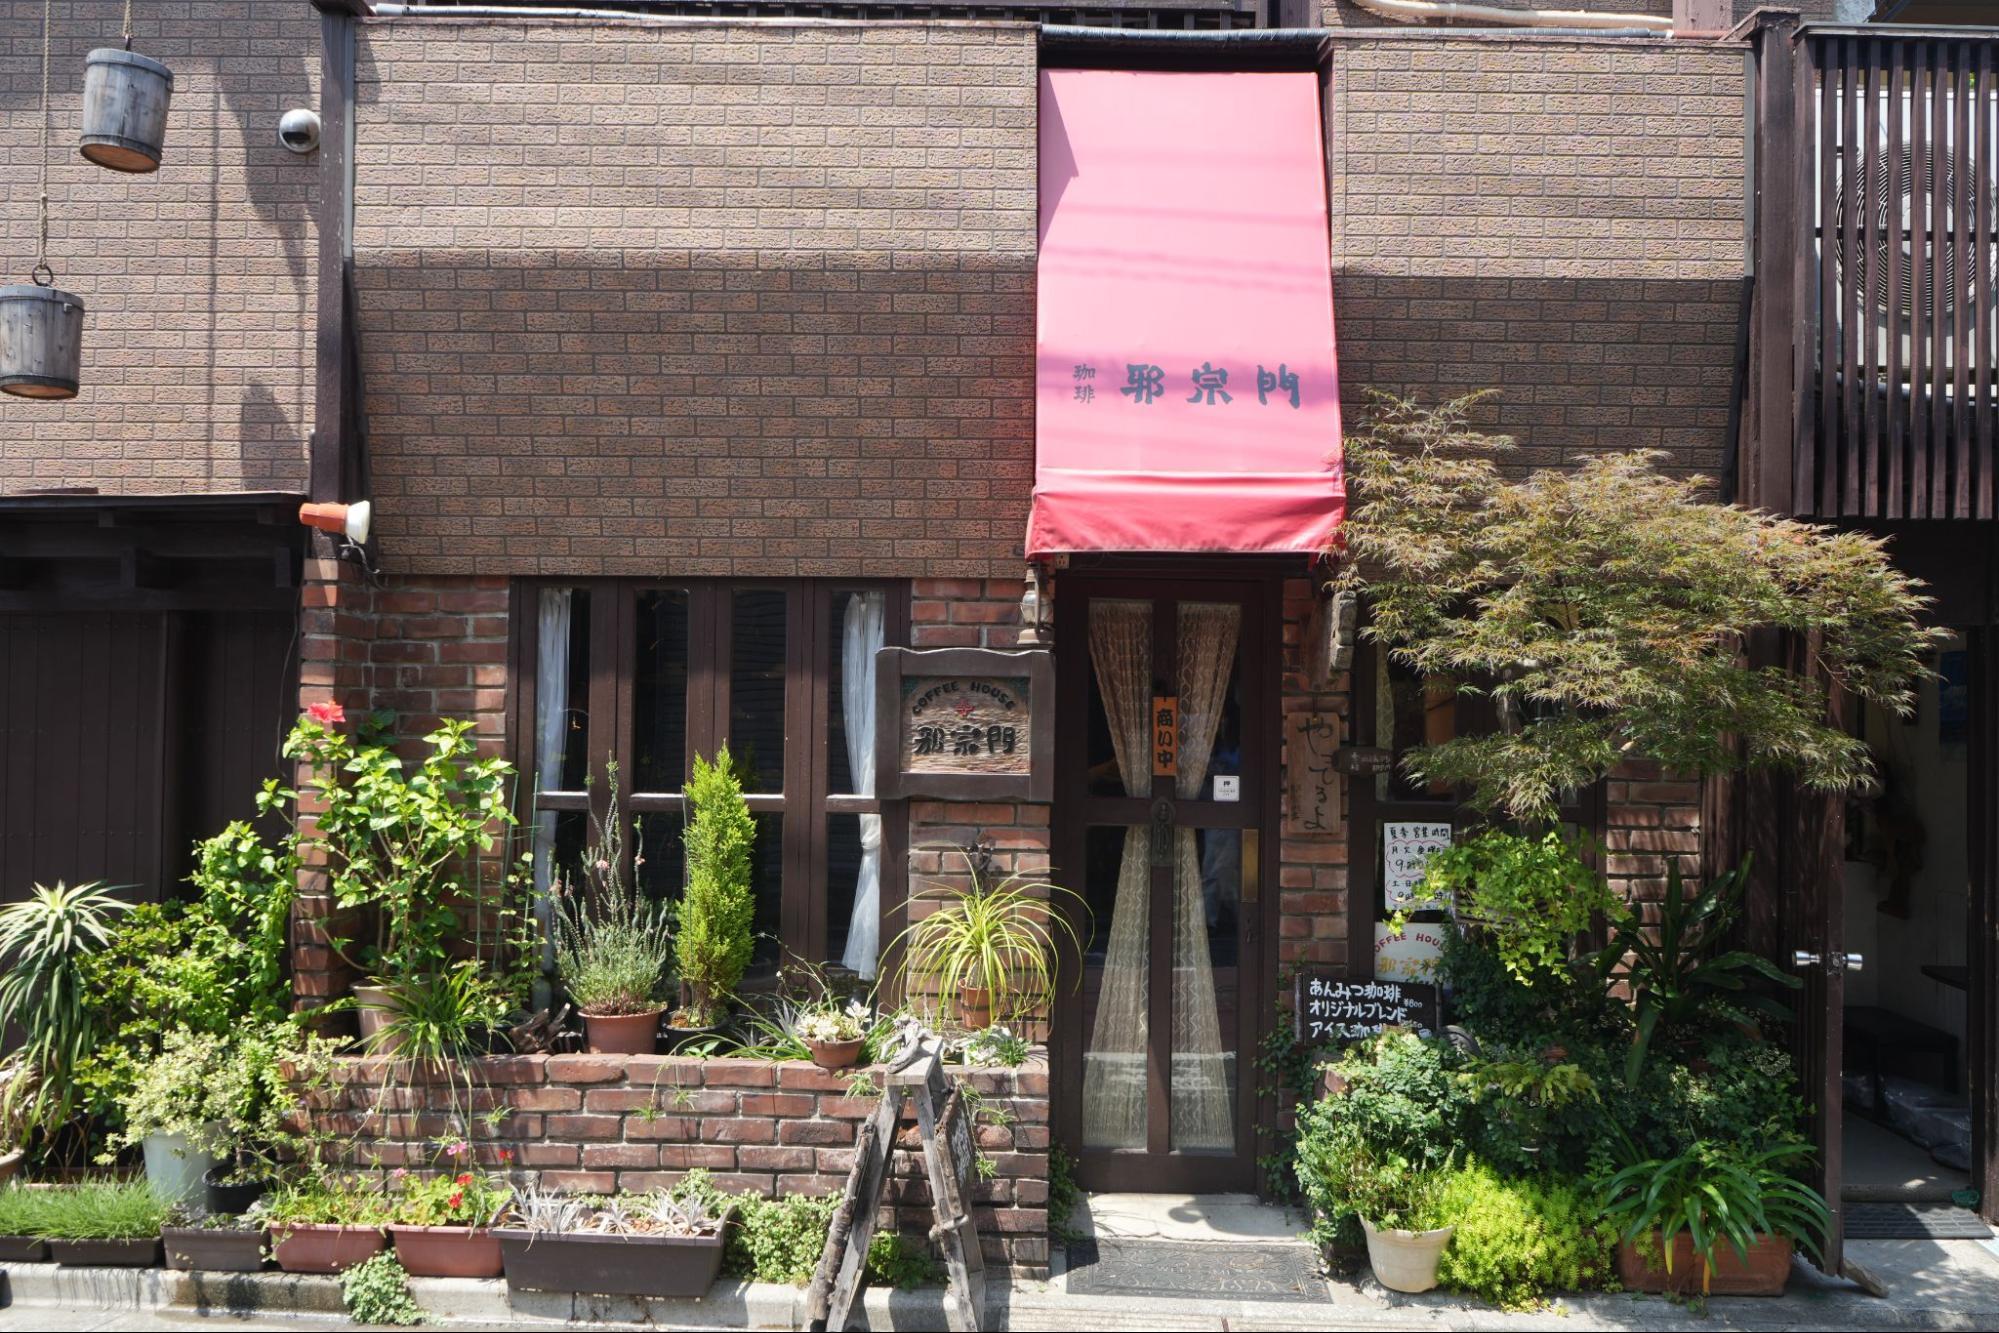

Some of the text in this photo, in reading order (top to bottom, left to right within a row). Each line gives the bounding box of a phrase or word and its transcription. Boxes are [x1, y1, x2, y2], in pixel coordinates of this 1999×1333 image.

[1072, 363, 1096, 404] 珈琲
[1120, 362, 1300, 409] 邪宗門
[912, 681, 1017, 715] COFFEE HOUSE
[1156, 708, 1174, 768] 商い中
[1415, 933, 1442, 951] HOU
[1309, 978, 1402, 1003] あんみつ珈琲
[1309, 1000, 1408, 1022] オリジナルブレンド
